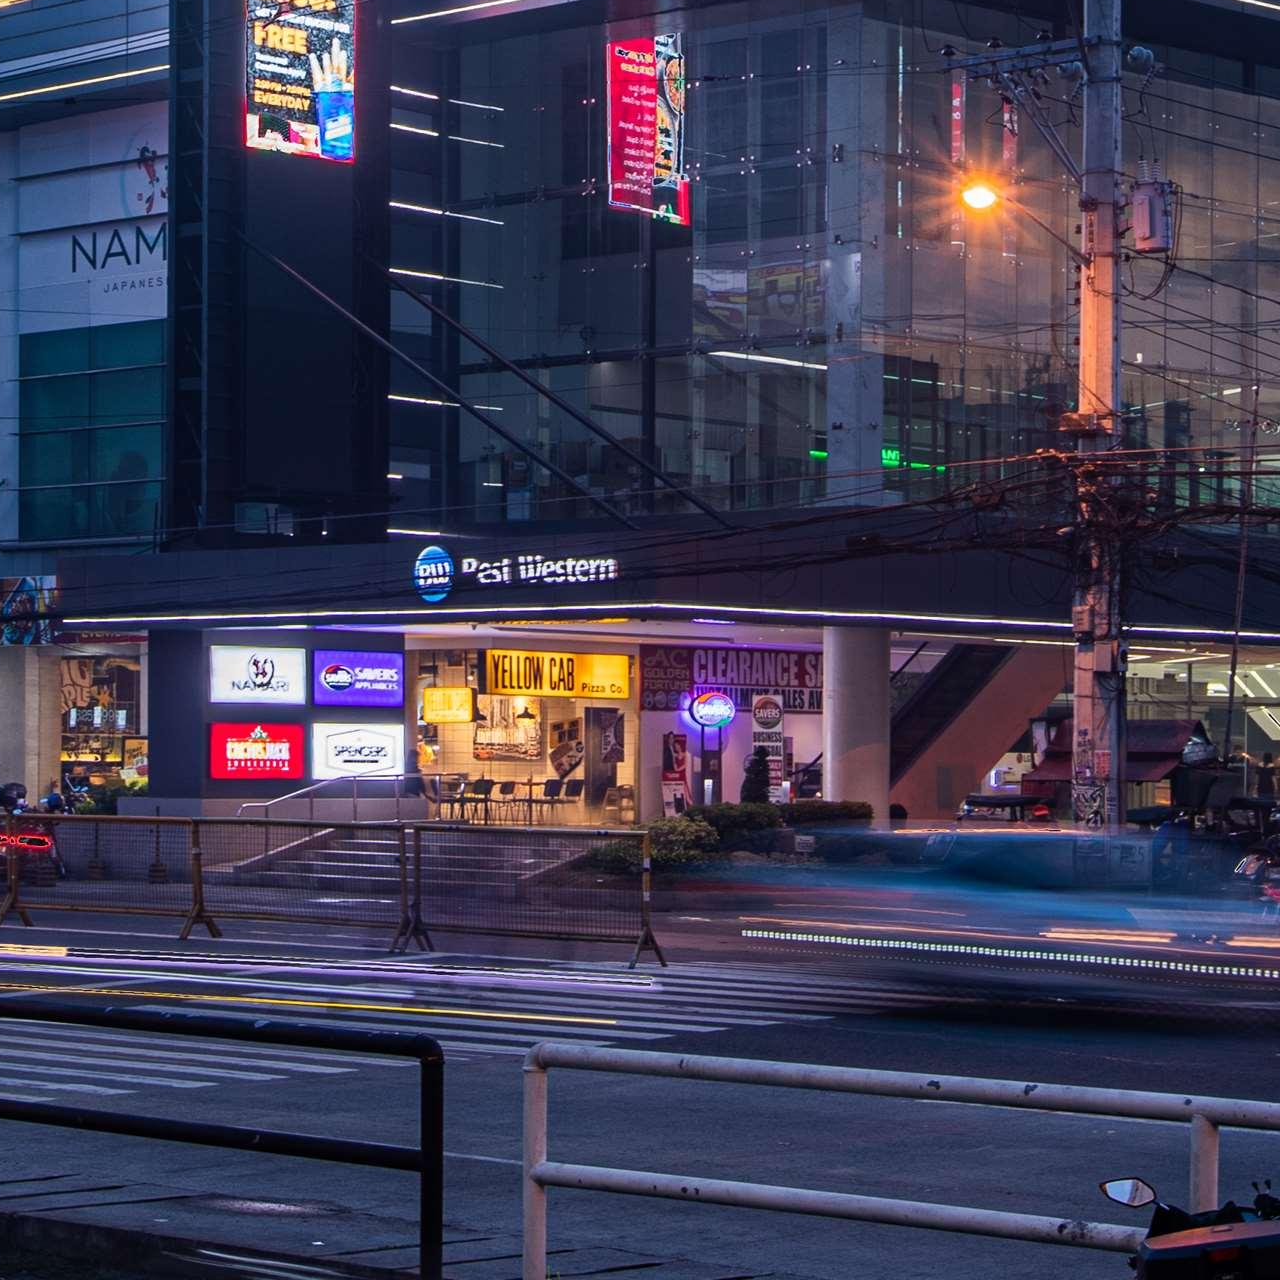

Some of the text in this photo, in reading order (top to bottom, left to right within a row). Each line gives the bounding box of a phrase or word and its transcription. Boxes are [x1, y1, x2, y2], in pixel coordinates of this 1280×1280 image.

[253, 20, 308, 55] FREE
[103, 276, 168, 294] JAPANES
[518, 554, 620, 584] Western
[354, 667, 399, 682] SAVERS
[492, 653, 625, 694] YELLOW CAB Pizza Co.
[643, 669, 690, 679] GOLDEN
[693, 649, 799, 687] CLEARANCE
[231, 679, 291, 693] NAMARI
[354, 681, 399, 691] APPLIANCES
[643, 679, 691, 690] FORTUNE
[754, 706, 781, 720] SAVERS
[753, 731, 782, 743] BUSINESS
